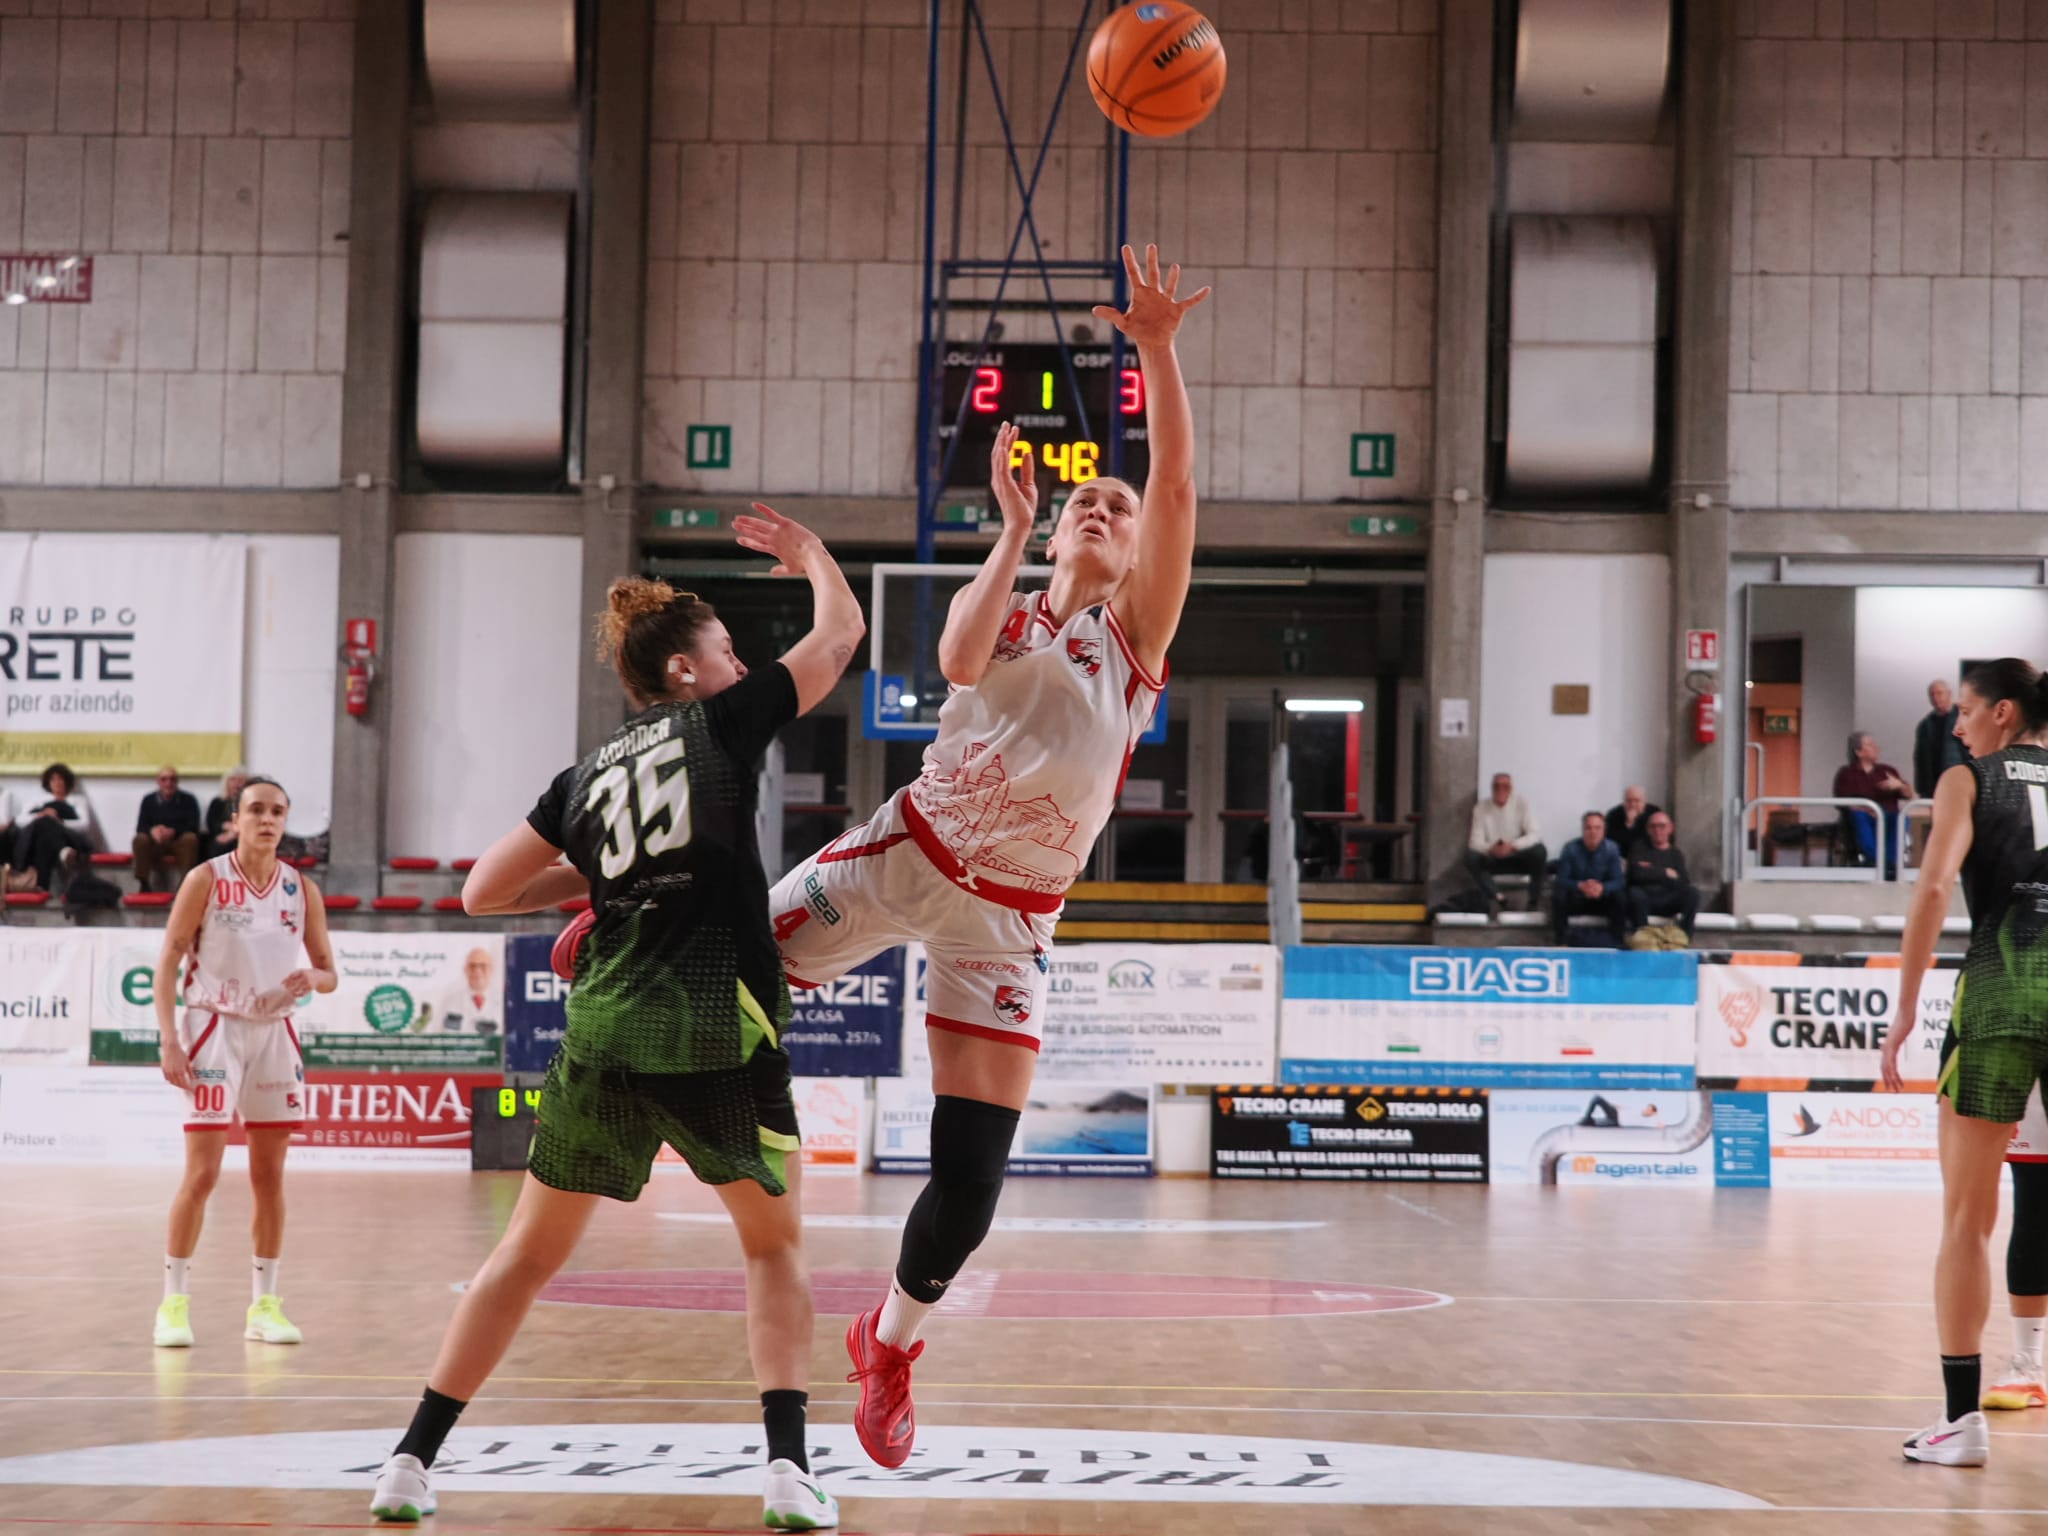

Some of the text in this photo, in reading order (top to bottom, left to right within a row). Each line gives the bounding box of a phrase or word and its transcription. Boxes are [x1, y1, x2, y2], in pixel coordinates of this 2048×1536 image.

[973, 368, 1146, 414] 2 1 3
[1043, 442, 1099, 483] 46
[10, 606, 136, 626] RUPPO
[1000, 609, 1029, 645] 4
[0, 632, 134, 681] RETE
[7, 690, 134, 718] per aziende
[585, 737, 691, 880] 35
[803, 867, 841, 927] Telea
[773, 906, 811, 941] 4
[1108, 972, 1155, 989] KNX
[1410, 957, 1570, 997] BIASI
[805, 1009, 845, 1024] CASA
[1770, 987, 1888, 1017] TECNO
[1138, 1024, 1222, 1035] AUTOMATION
[1770, 1019, 1889, 1050] CRANE
[195, 1084, 225, 1111] 00
[1234, 1098, 1287, 1114] TECNO
[1387, 1102, 1437, 1117] TECNO
[1828, 1106, 1921, 1129] ANDOS
[312, 1130, 411, 1145] RESTAURI
[482, 1441, 1332, 1467] Indutrial
